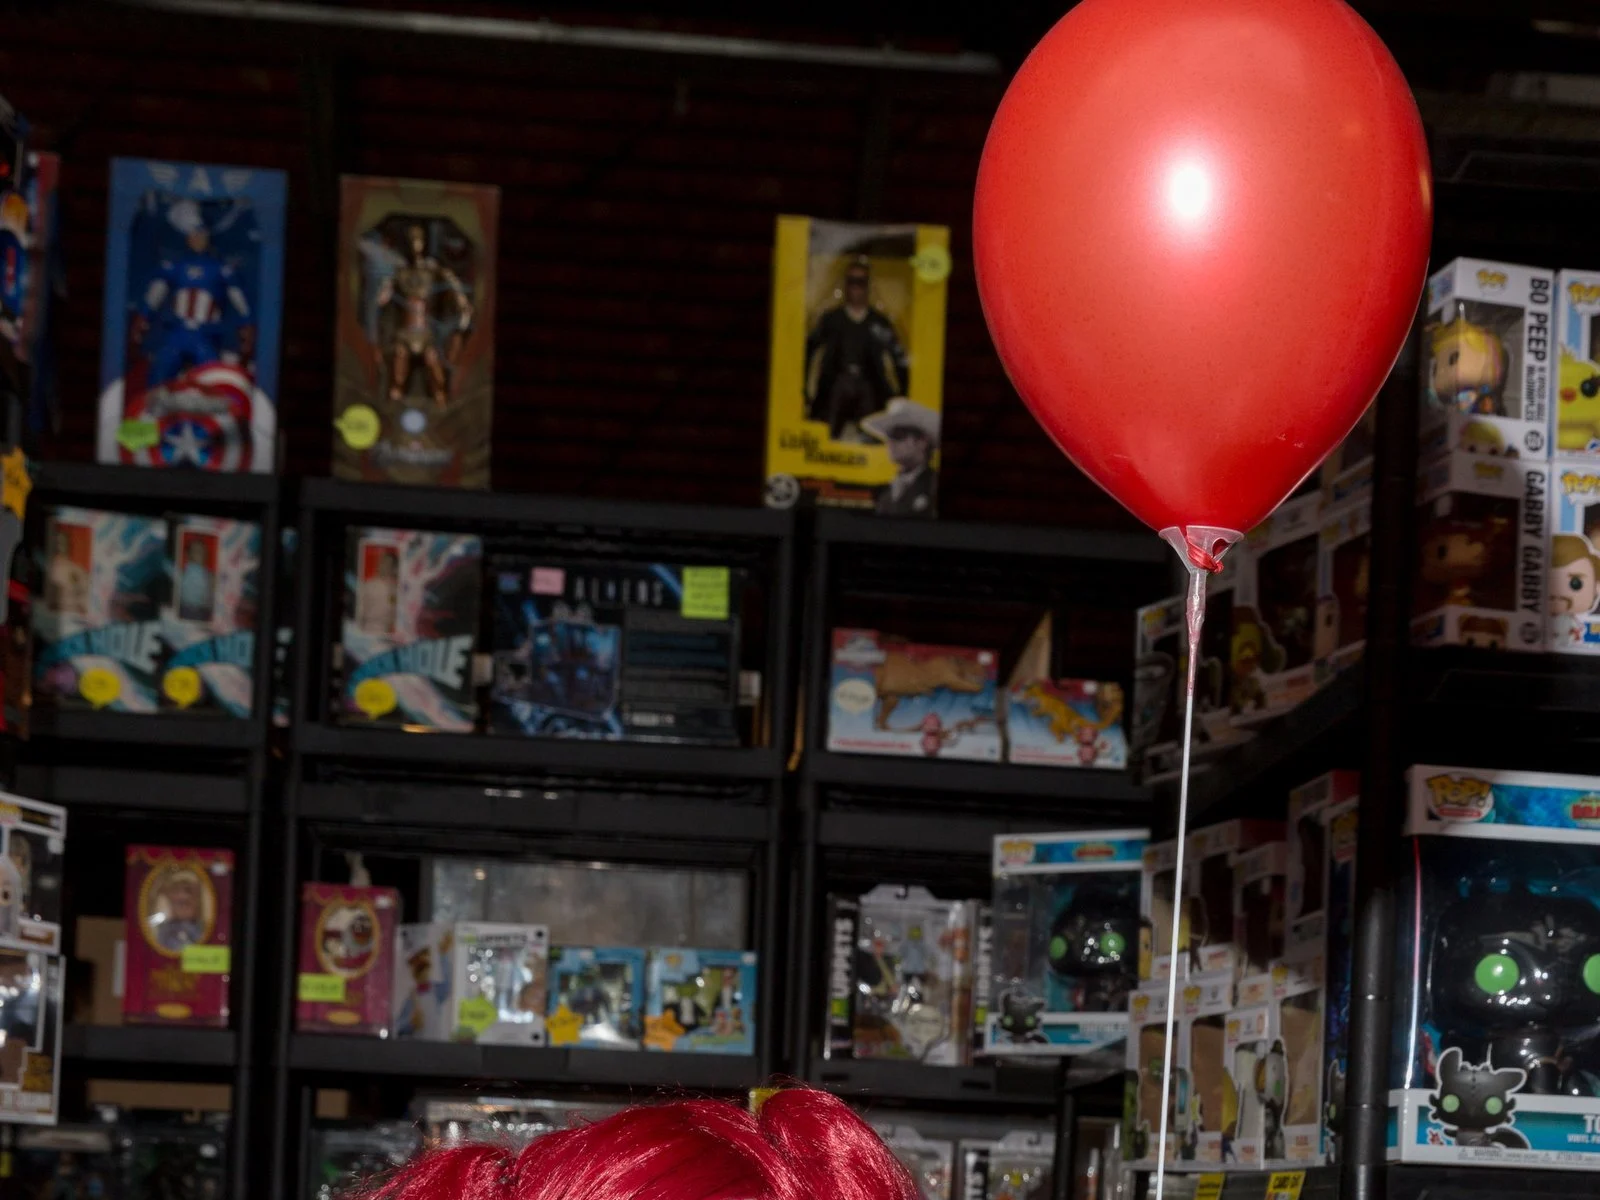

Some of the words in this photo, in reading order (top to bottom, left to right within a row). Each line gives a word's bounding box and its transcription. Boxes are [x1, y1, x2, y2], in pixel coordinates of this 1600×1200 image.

[1529, 278, 1549, 304] BO
[1528, 311, 1549, 361] PEEP
[1524, 471, 1545, 538] GABBY
[1521, 546, 1543, 613] GABBY
